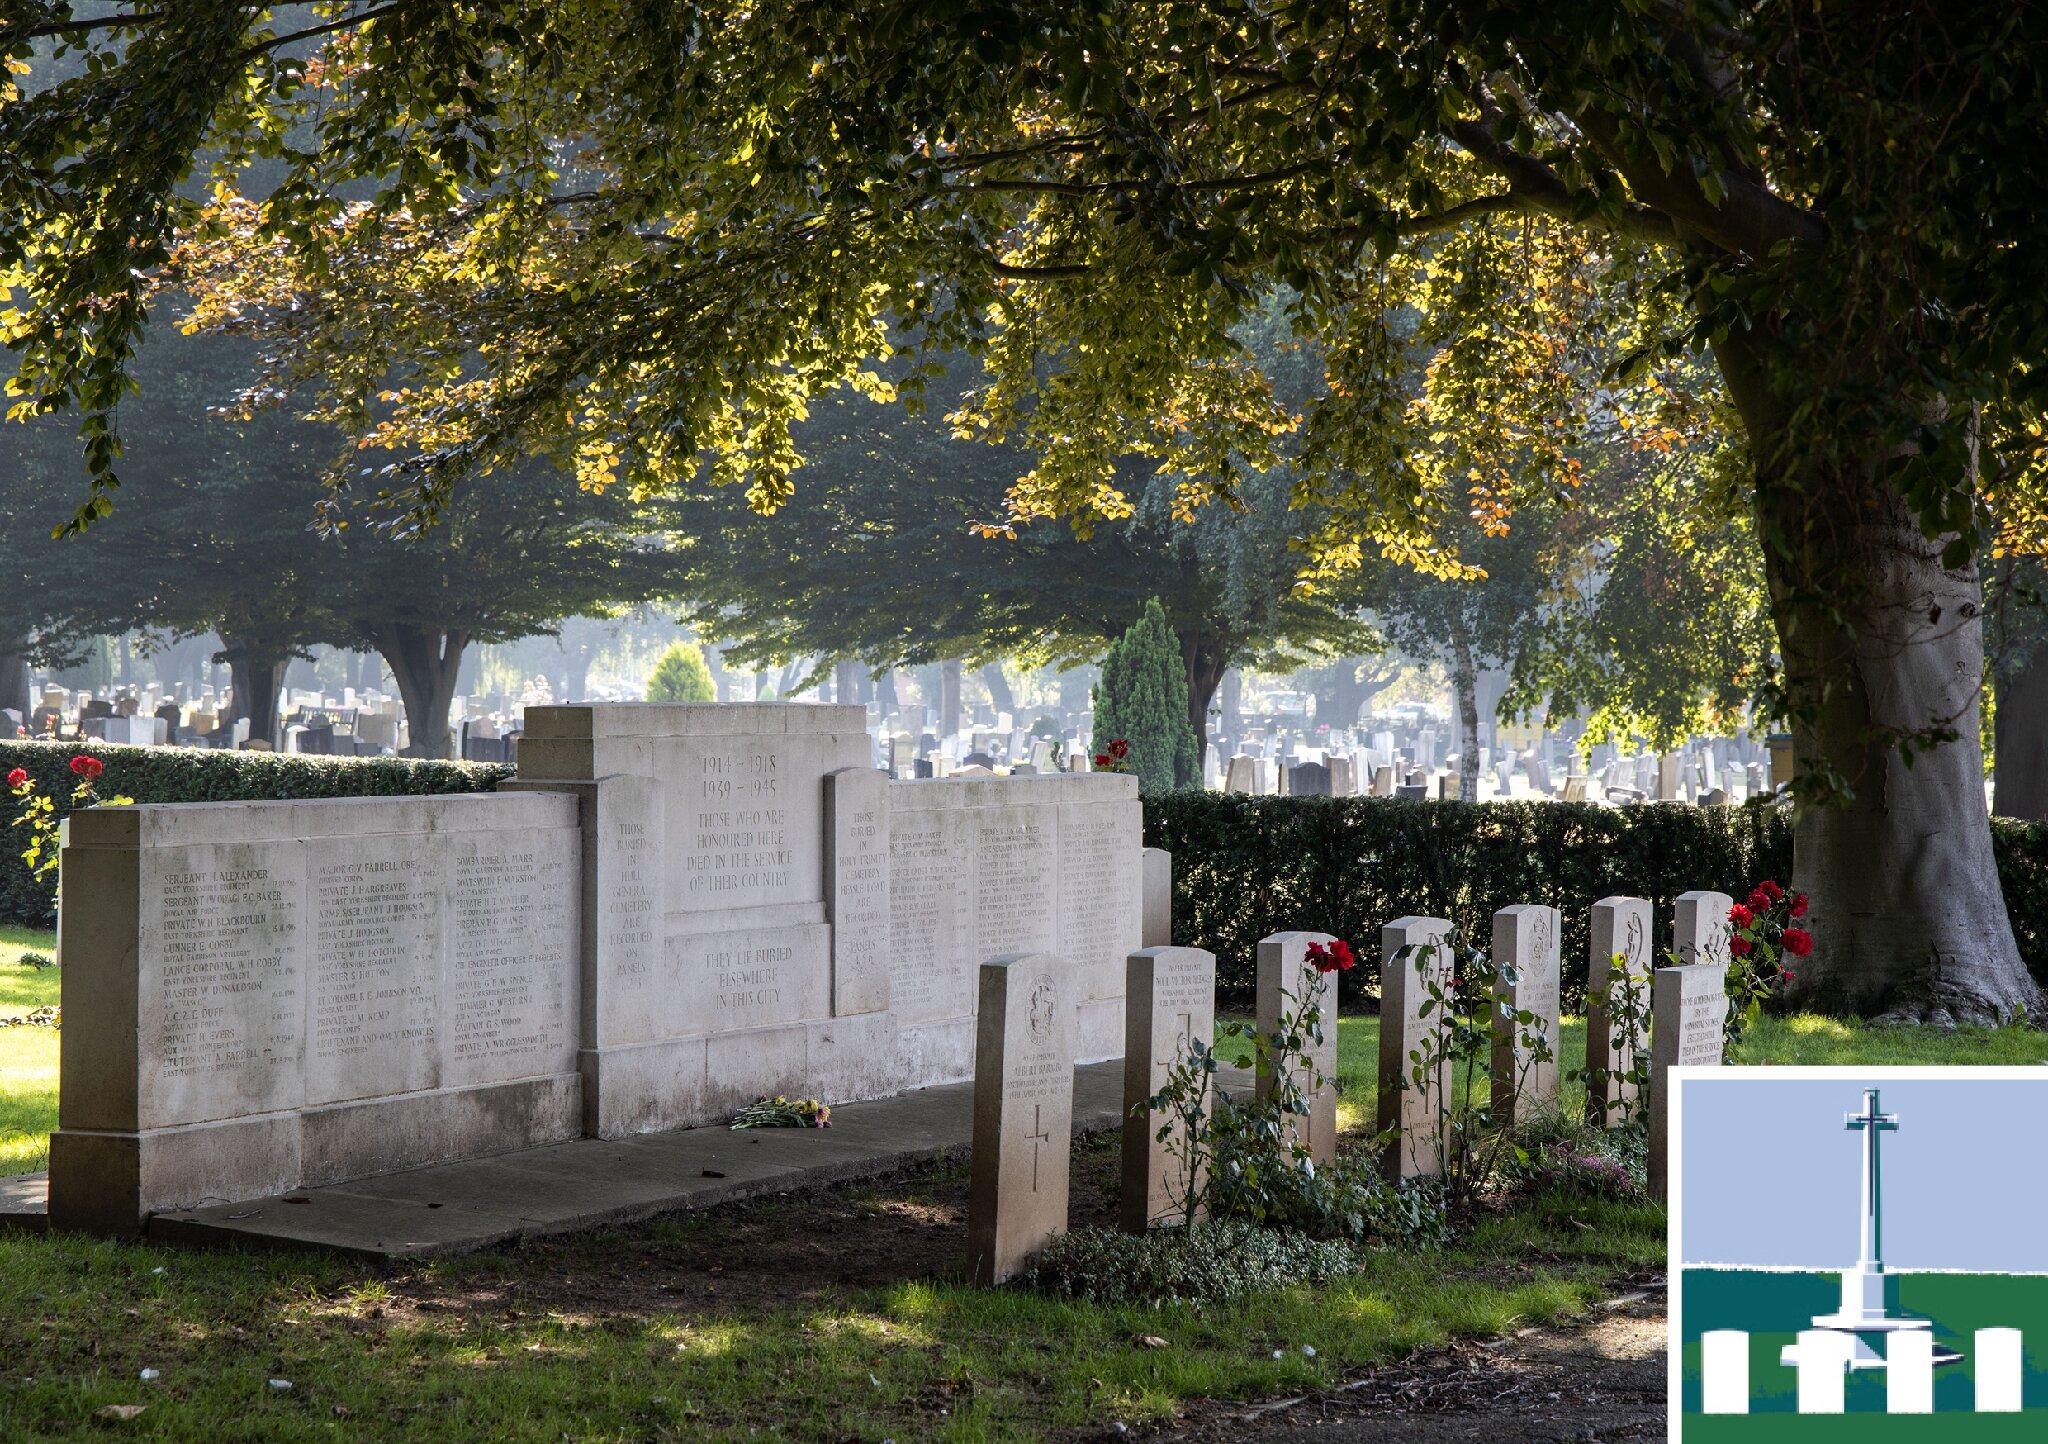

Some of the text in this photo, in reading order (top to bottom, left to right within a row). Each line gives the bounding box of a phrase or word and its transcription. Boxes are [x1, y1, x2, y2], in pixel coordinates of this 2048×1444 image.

[702, 756, 733, 774] 1914
[750, 754, 777, 774] 1918
[702, 779, 731, 800] 1939
[750, 778, 777, 798] 1945
[697, 809, 785, 828] THOSE WHO ARE
[854, 811, 874, 824] THOSE
[619, 822, 645, 836] THOSE
[697, 830, 785, 849] HONOURED HERE
[860, 840, 869, 852] IN
[627, 854, 639, 867] IN
[687, 850, 793, 871] DIED IN THE SERVICE
[840, 852, 887, 868] HOLY TRINITY
[164, 869, 268, 885] SERJEANT ALEXANDER
[621, 869, 643, 882] HULL
[690, 871, 790, 891] OF THEIR COUNTRY
[256, 890, 282, 902] BAKER
[610, 899, 653, 914] CEMETERY
[622, 916, 641, 930] ARE
[610, 930, 653, 946] RECORDED
[704, 947, 792, 969] THEY LIE BURIED
[164, 964, 191, 977] LANCE
[719, 968, 778, 988] ELSEWHERE
[213, 981, 263, 995] DONALDSON
[715, 988, 781, 1010] IN THIS CITY
[202, 1006, 225, 1019] DUFF
